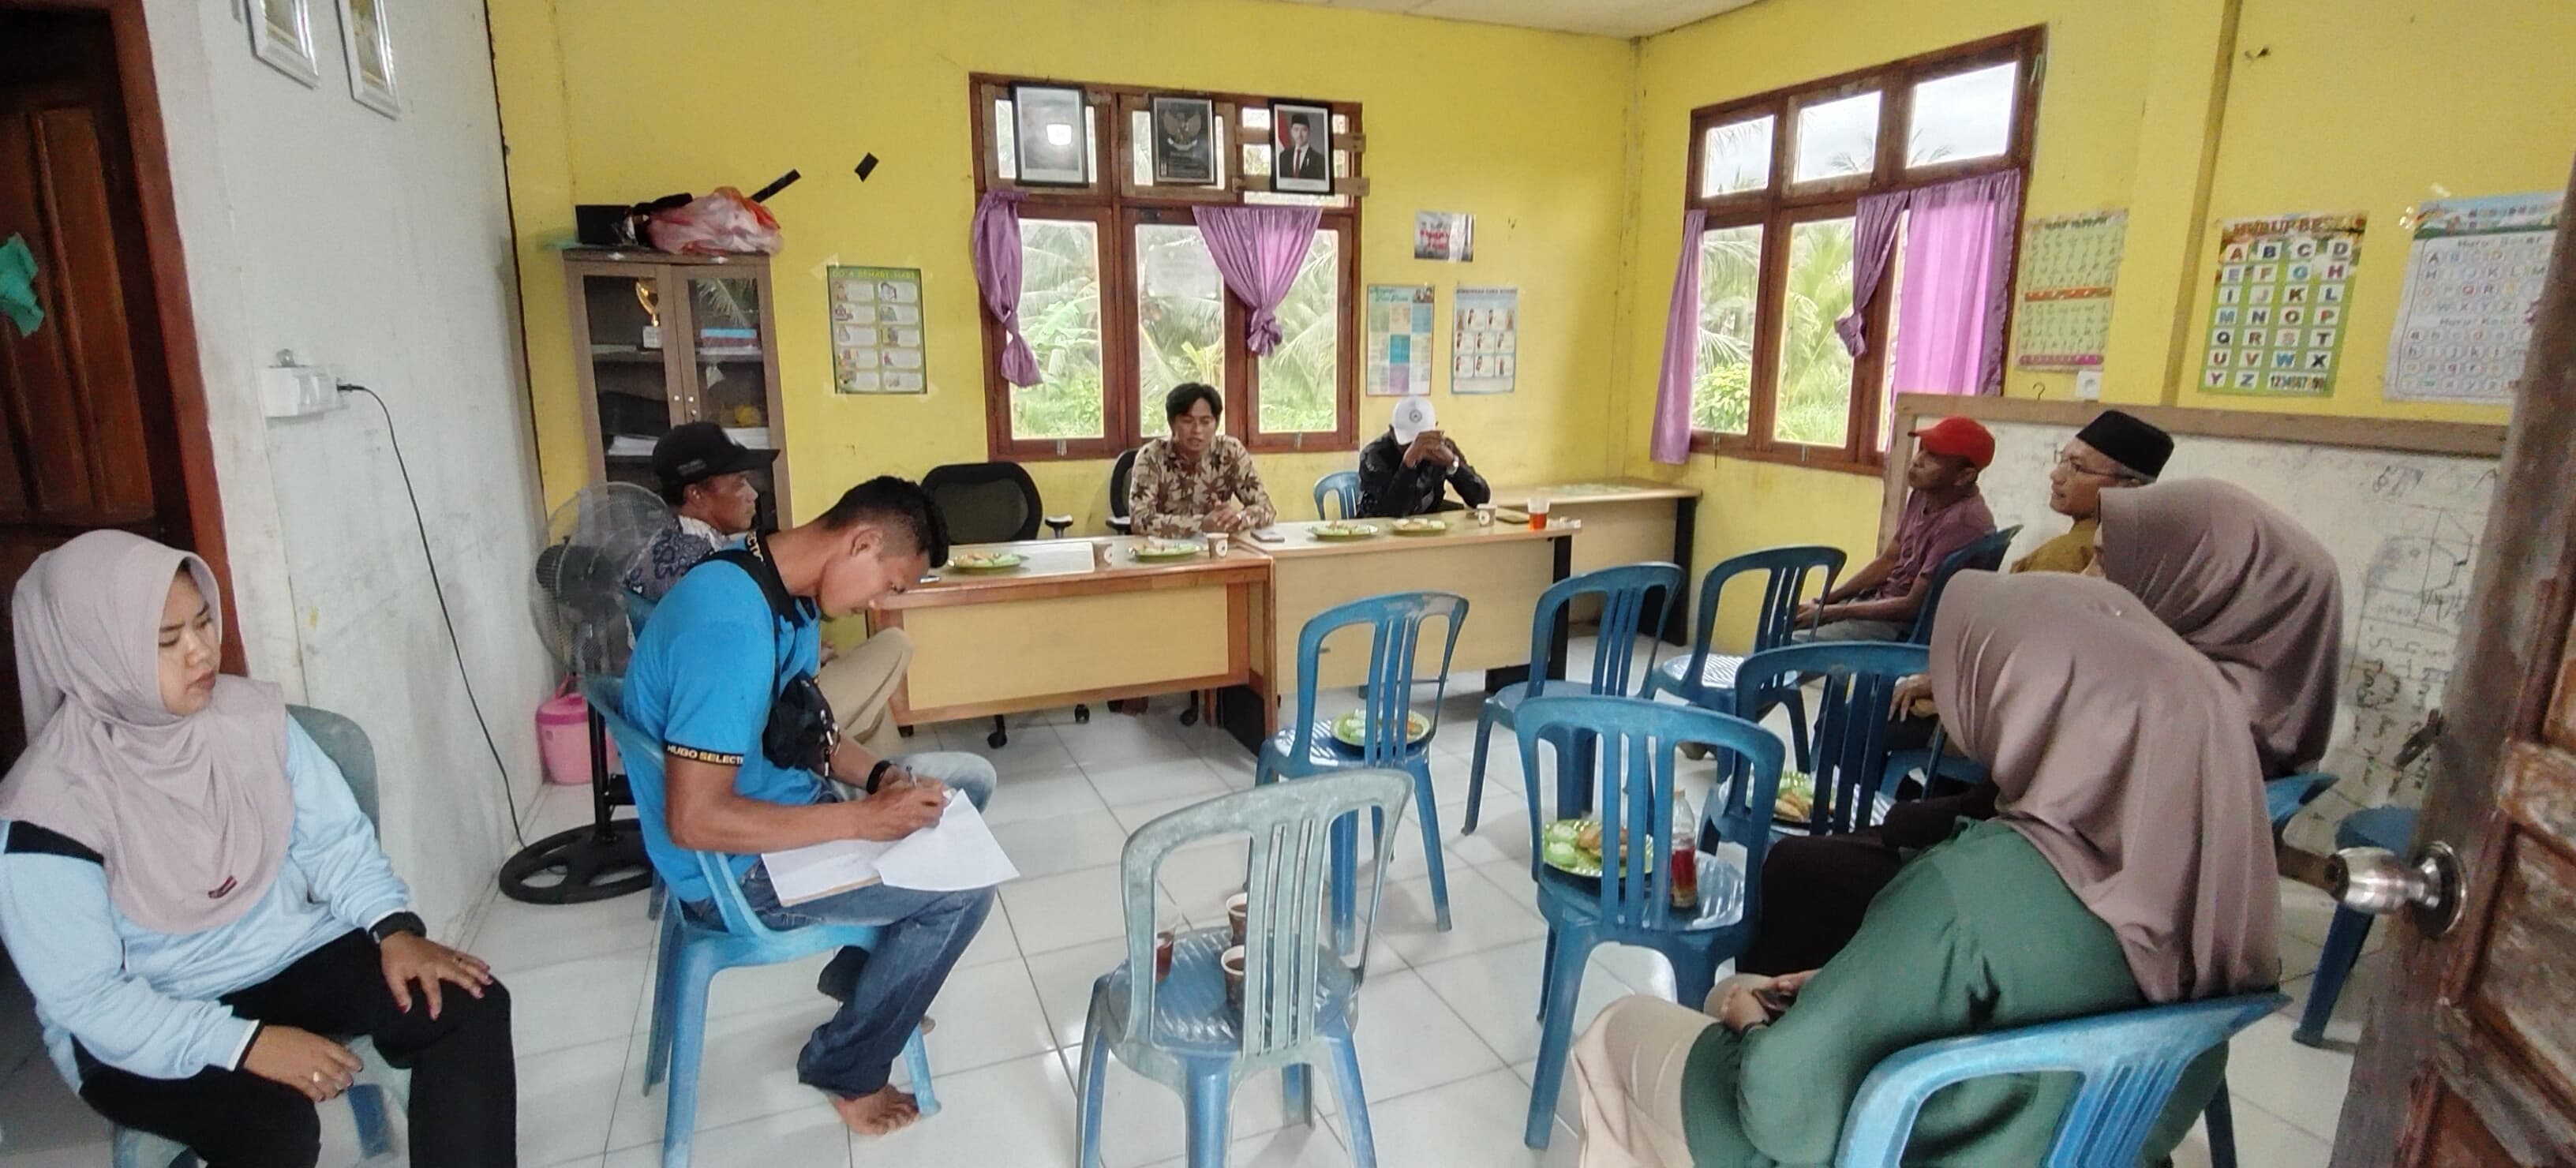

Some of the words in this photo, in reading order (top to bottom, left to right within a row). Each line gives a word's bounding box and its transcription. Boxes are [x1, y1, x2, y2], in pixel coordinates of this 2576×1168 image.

[2230, 247, 2243, 260] A
[2263, 245, 2276, 257] B
[2297, 243, 2312, 257] C
[2334, 241, 2349, 255] D
[2228, 268, 2241, 280] E
[2260, 267, 2272, 279] F
[2327, 264, 2344, 278] H
[2289, 287, 2305, 301] K
[2325, 288, 2338, 300] L
[2218, 310, 2236, 323] M
[2252, 310, 2267, 324] N
[2285, 309, 2300, 324] O
[2320, 309, 2335, 321] P
[2216, 331, 2230, 344] Q
[2248, 331, 2262, 344] R
[2317, 331, 2331, 345] T
[2213, 352, 2227, 365] U
[2245, 353, 2260, 365] V
[2275, 353, 2295, 365] W
[2312, 354, 2327, 368] X
[2211, 372, 2223, 384] Y
[2241, 373, 2254, 386] Z
